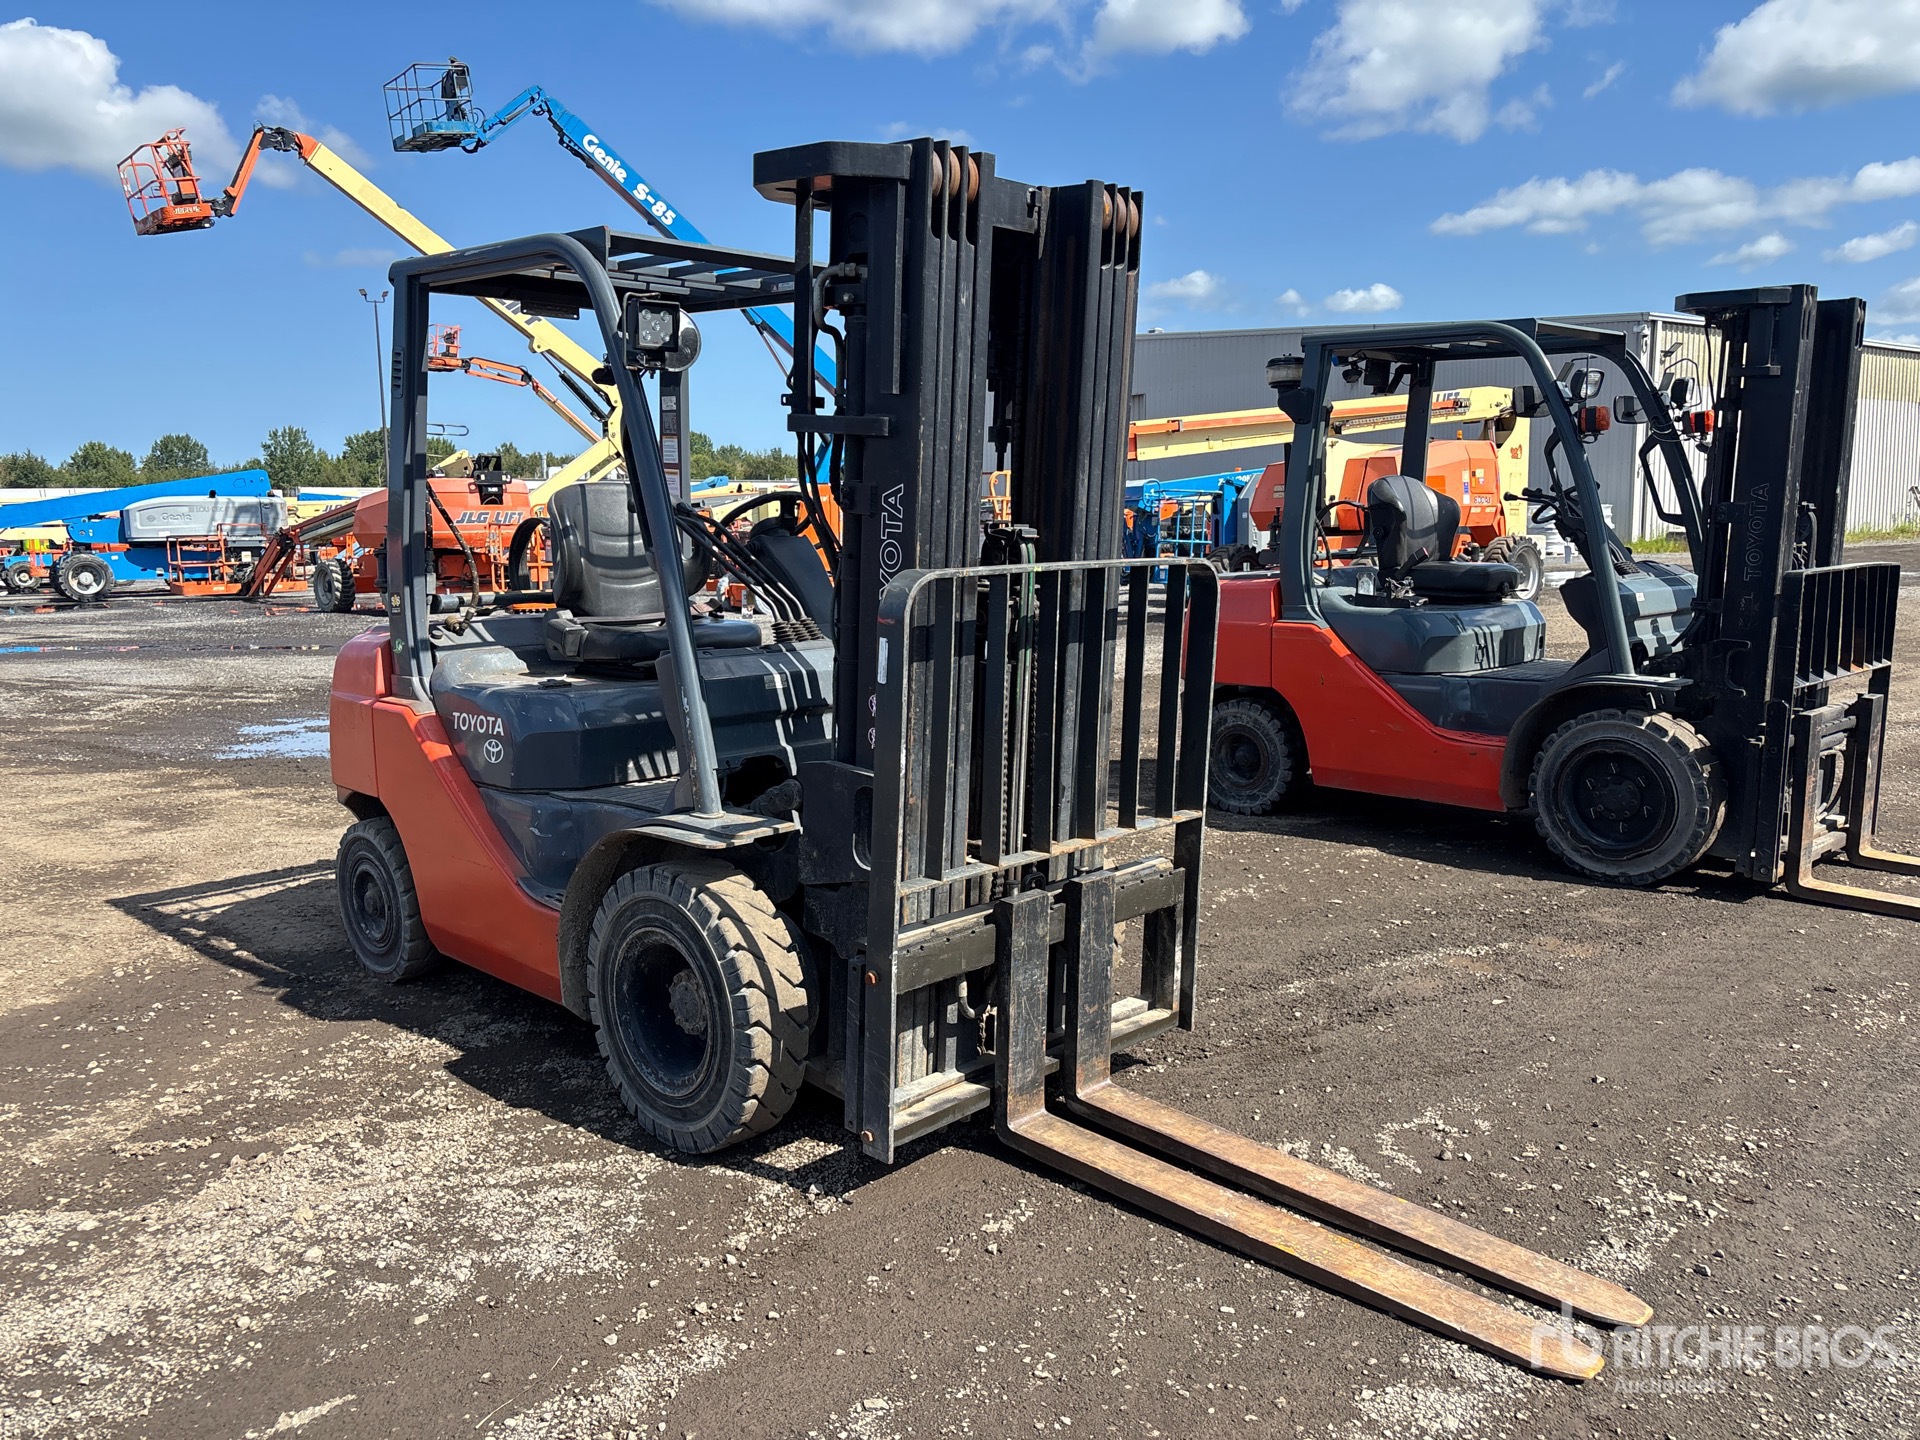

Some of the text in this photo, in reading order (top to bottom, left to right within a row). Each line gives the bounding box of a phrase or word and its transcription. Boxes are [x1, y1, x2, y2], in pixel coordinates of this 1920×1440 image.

[582, 134, 676, 225] Genie S-85
[455, 511, 524, 524] JLG LIFT
[1744, 482, 1769, 581] TOYOTA
[452, 711, 504, 736] TOYOTA
